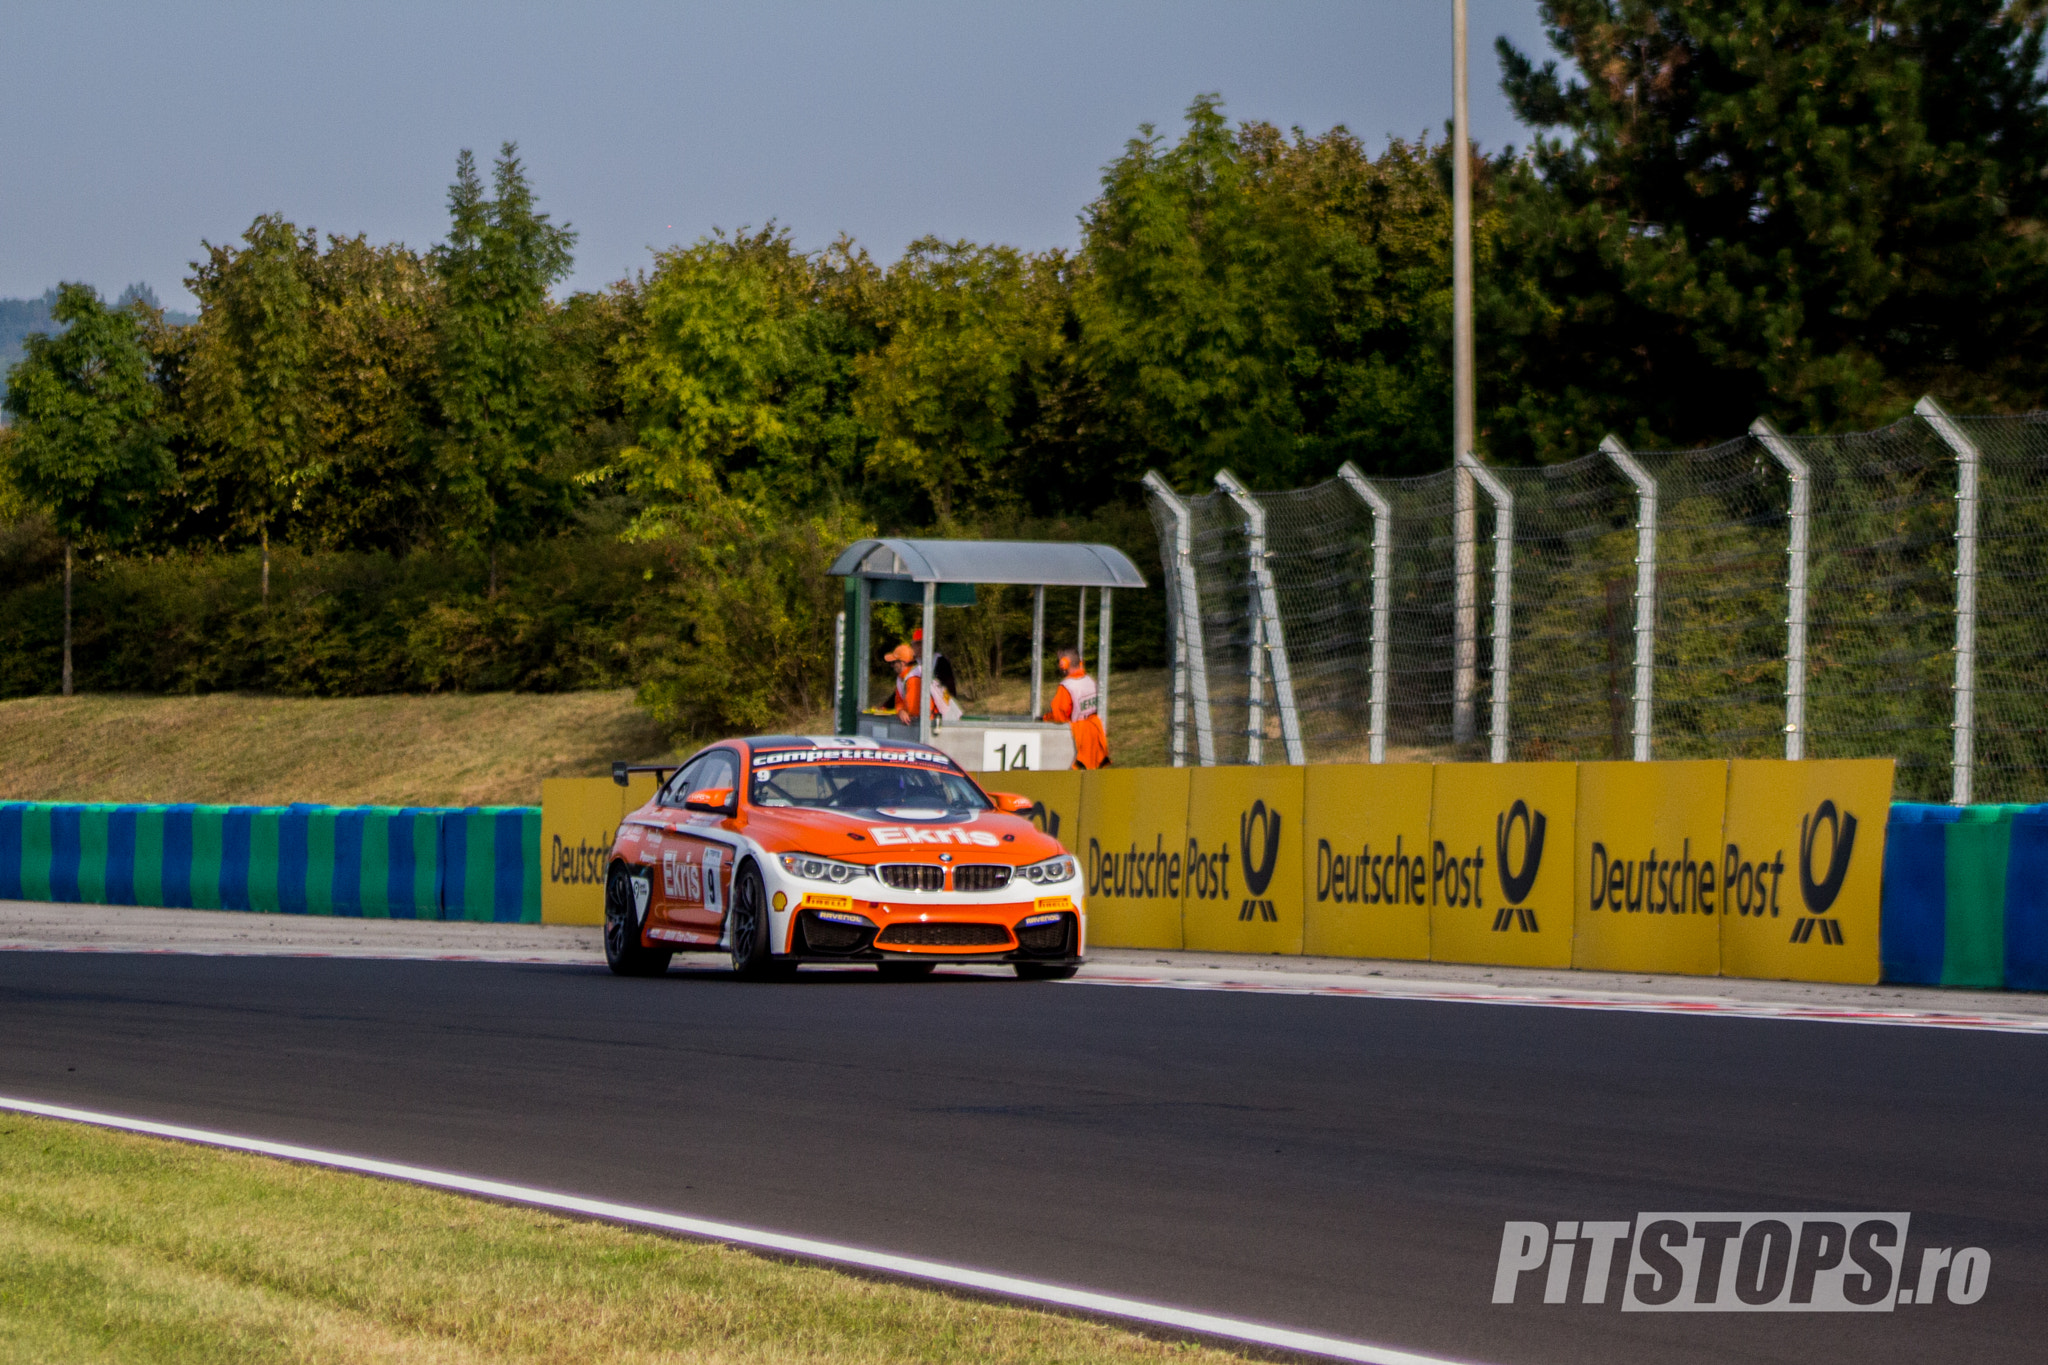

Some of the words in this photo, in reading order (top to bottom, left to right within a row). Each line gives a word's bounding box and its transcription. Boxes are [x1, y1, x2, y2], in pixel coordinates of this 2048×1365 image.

[994, 744, 1030, 771] 14
[756, 769, 771, 782] 9
[869, 826, 1000, 847] Ekris
[663, 849, 701, 902] Ekris
[1089, 833, 1181, 898] Deutsche
[1185, 837, 1230, 900] Post
[1317, 834, 1427, 906] Deutsche
[1433, 840, 1485, 909] Post
[1590, 837, 1716, 916] Deutsche
[1724, 843, 1785, 918] Post
[707, 868, 716, 904] 9
[806, 895, 848, 907] PIRELLI
[1038, 898, 1069, 909] PIRELLI
